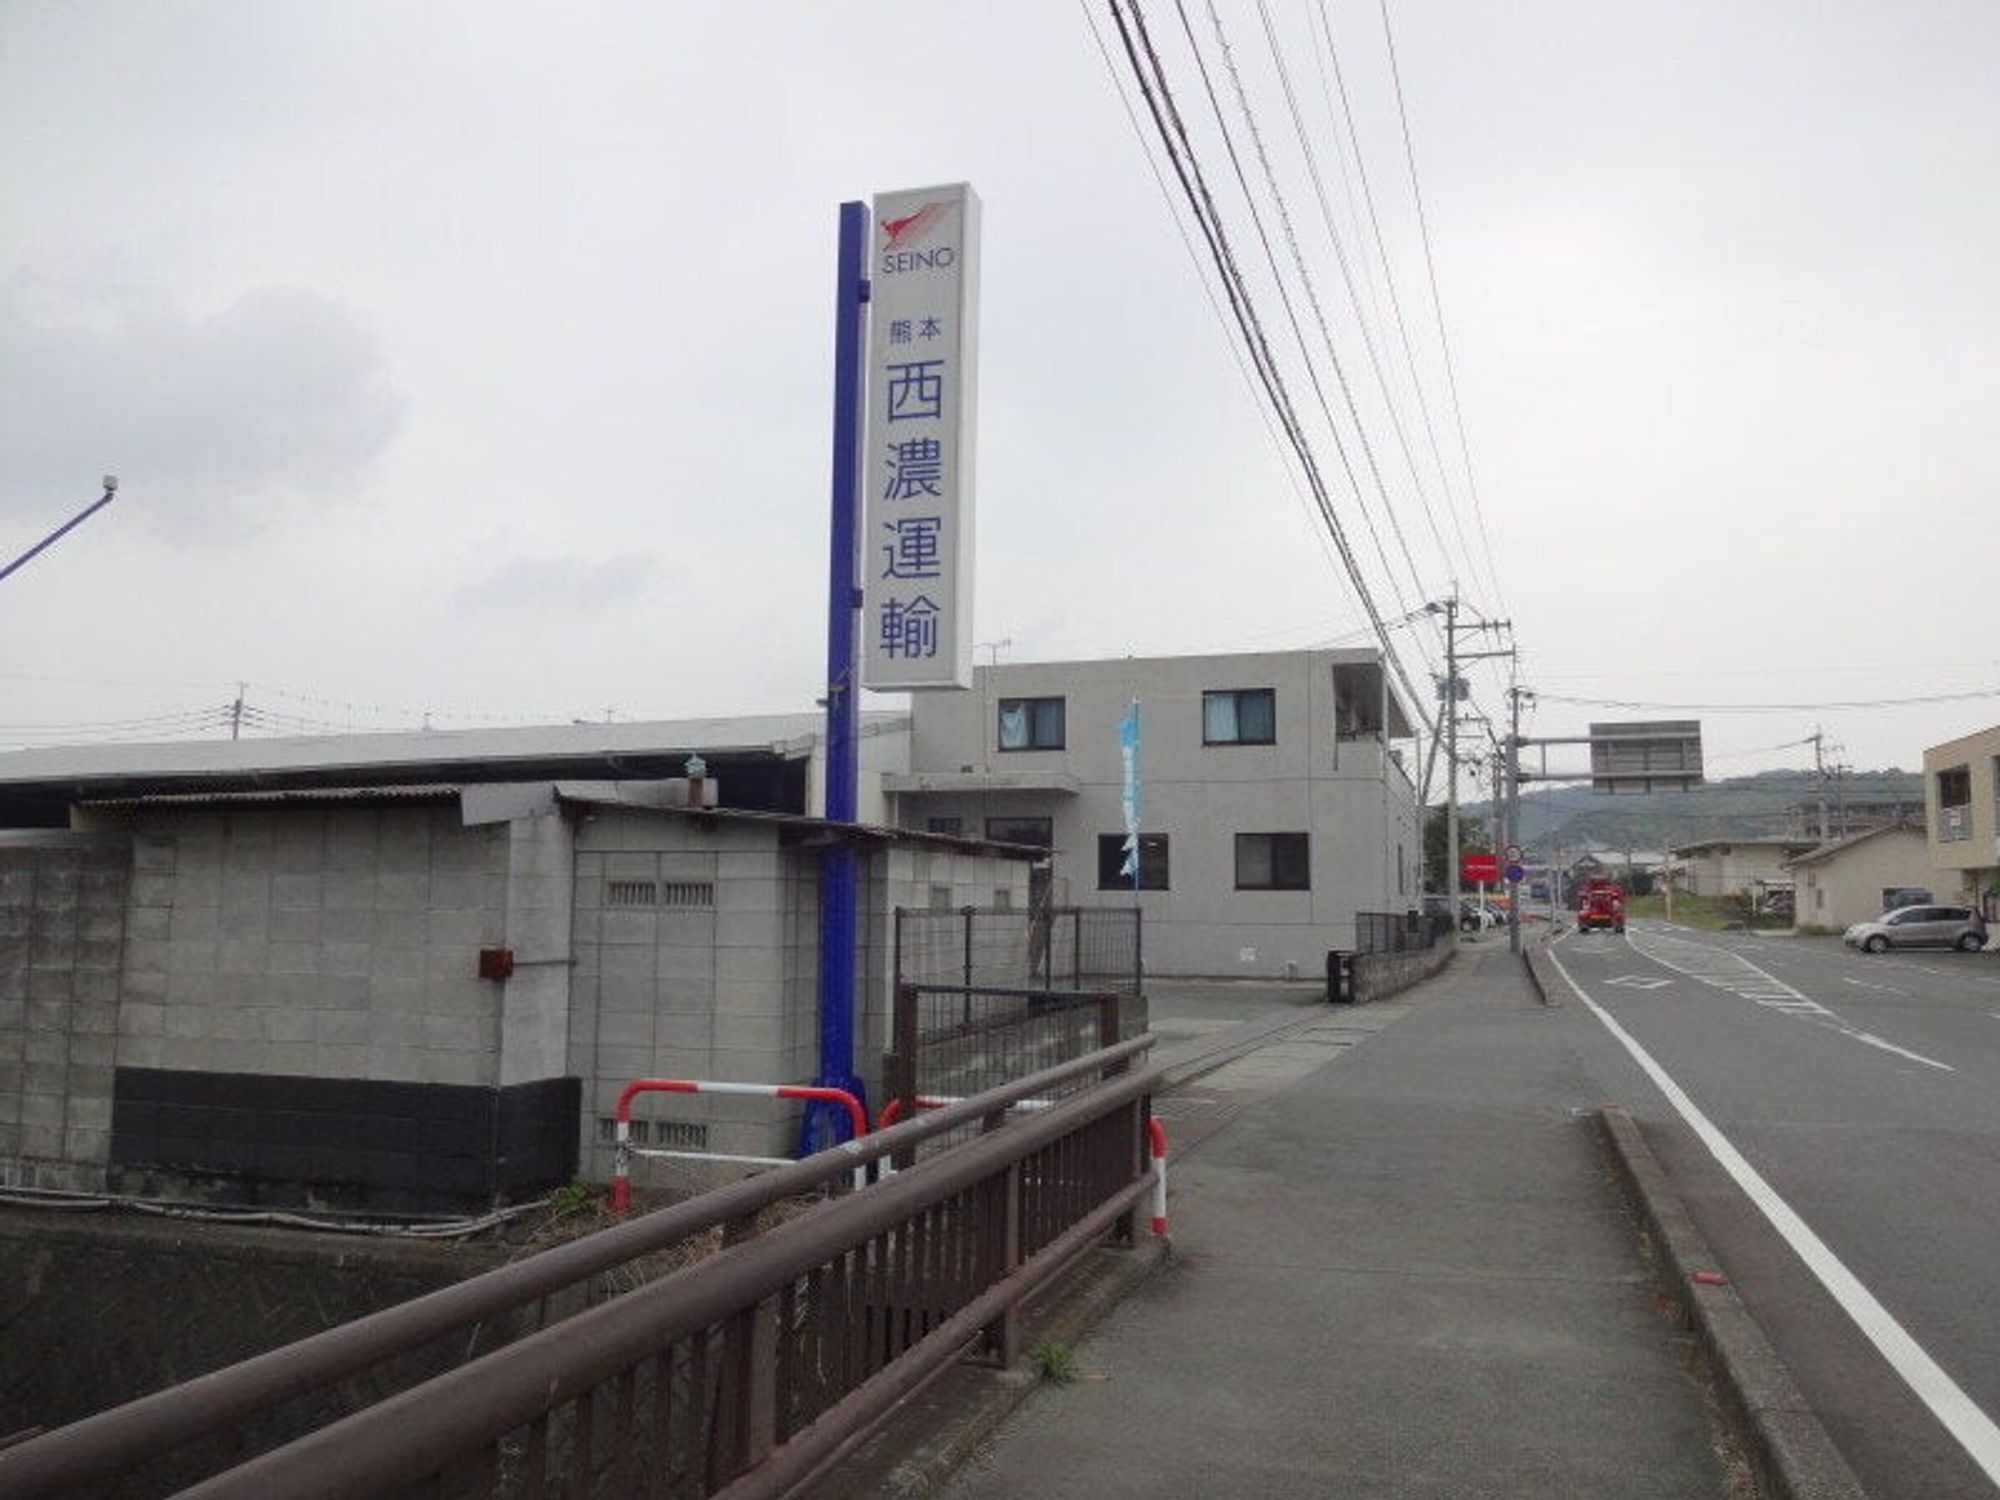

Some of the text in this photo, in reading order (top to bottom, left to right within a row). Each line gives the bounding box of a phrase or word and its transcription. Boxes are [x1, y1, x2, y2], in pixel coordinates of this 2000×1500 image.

[882, 247, 955, 274] SEINO
[890, 316, 942, 344] 熊本
[880, 360, 945, 661] 西濃運輸
